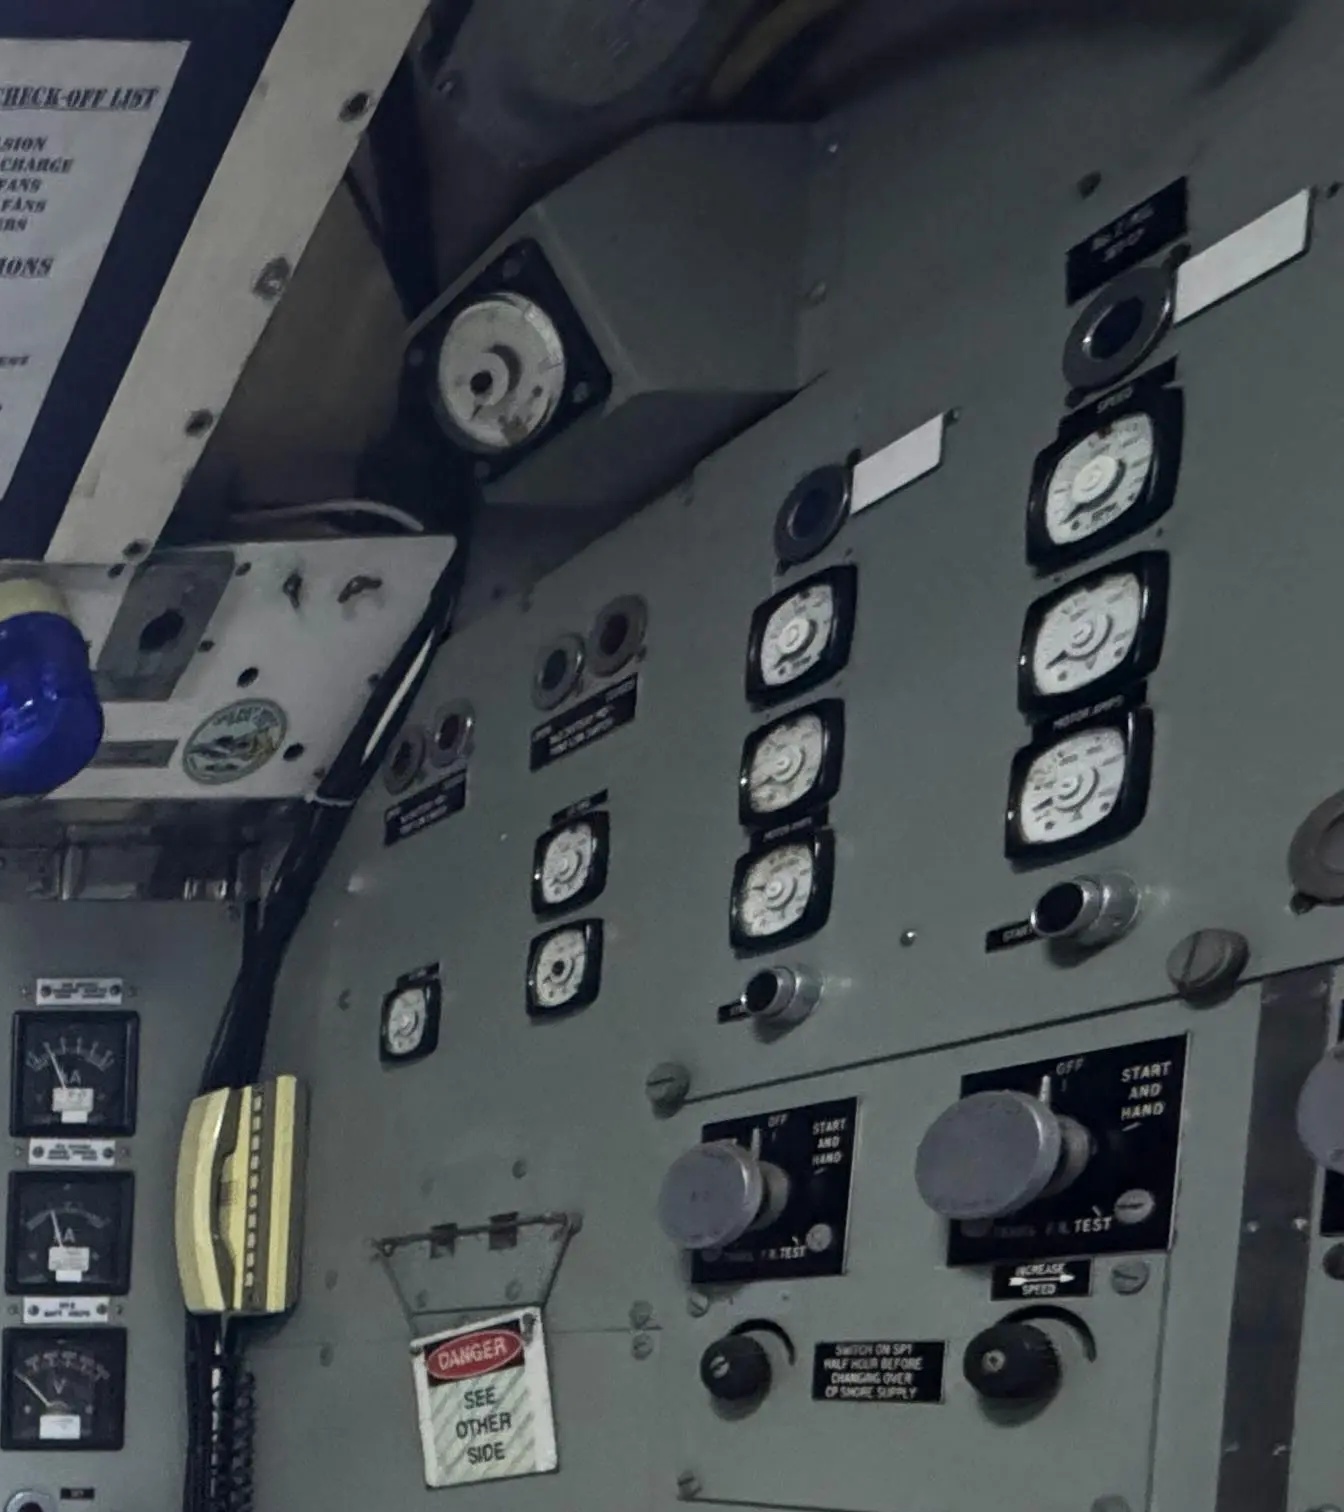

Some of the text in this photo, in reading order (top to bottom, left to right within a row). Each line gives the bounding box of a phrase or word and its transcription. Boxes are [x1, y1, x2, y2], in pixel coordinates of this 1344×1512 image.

[110, 87, 159, 109] LIST
[0, 158, 74, 174] CHARGE
[0, 199, 47, 213] FANS
[1057, 1058, 1084, 1075] OFF
[1122, 1062, 1172, 1082] START
[1128, 1084, 1162, 1100] AND
[1121, 1102, 1165, 1120] HAND
[813, 1118, 846, 1135] START
[818, 1136, 840, 1148] AND
[813, 1151, 842, 1164] HAND
[1075, 1217, 1111, 1233] TEST
[780, 1246, 806, 1260] TEST
[1022, 1284, 1056, 1295] SPEED
[438, 1337, 509, 1370] DANGER
[836, 1344, 873, 1356] SWITCH
[877, 1344, 890, 1356] ON
[824, 1358, 923, 1370] HALF HOUR BEFORE
[831, 1372, 912, 1384] CHANGING OVER
[464, 1387, 496, 1409] SEE
[840, 1387, 874, 1398] SHORE
[876, 1387, 918, 1400] SUPPLY
[456, 1412, 512, 1439] OTHER
[467, 1442, 505, 1464] SIDE
